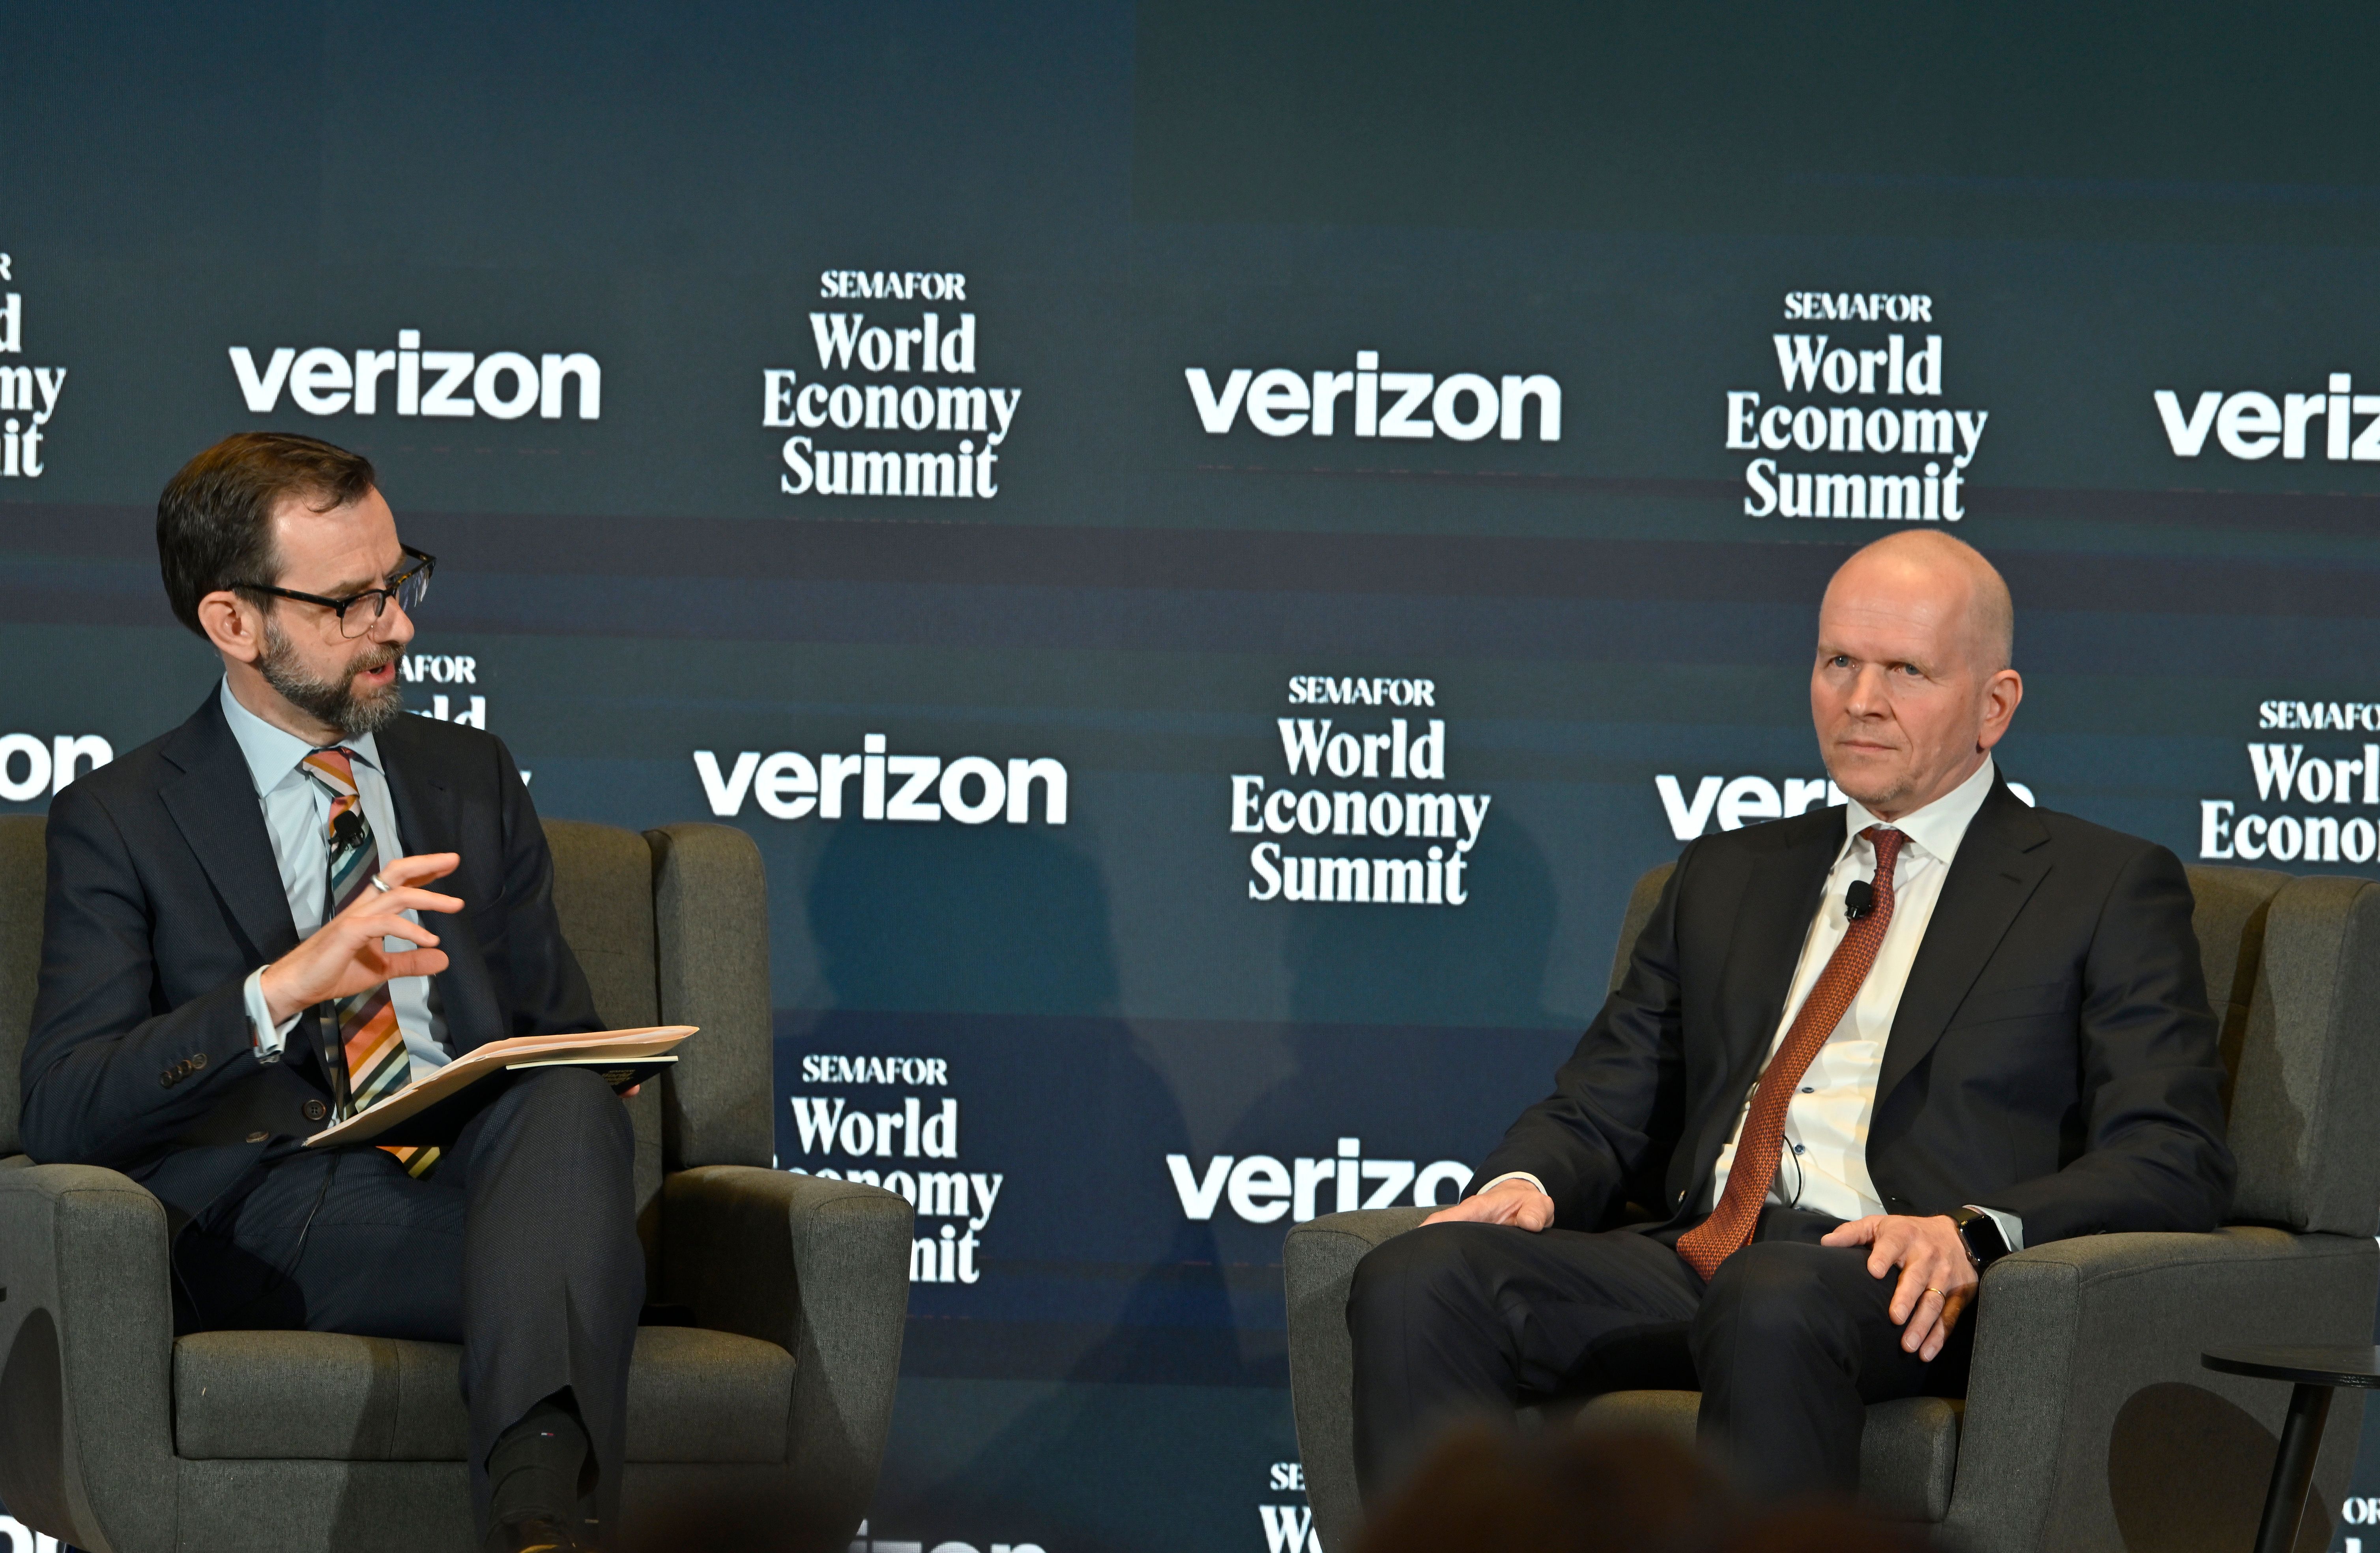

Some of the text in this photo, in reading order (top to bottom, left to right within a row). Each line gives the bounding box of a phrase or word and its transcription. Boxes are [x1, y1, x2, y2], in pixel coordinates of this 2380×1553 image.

[821, 270, 966, 301] SEMAFOR
[1785, 292, 1932, 322] SEMAFOR
[809, 312, 976, 373] World
[1773, 334, 1942, 395] World
[228, 329, 601, 420] verizon
[1184, 350, 1561, 442] verizon
[763, 369, 1022, 445] Economy
[1726, 390, 1988, 468] Economy
[781, 436, 998, 498] Summit
[1744, 458, 1965, 521] Summit
[1288, 676, 1435, 707] SEMAFOR
[693, 733, 1067, 825] verizon
[1277, 718, 1445, 779] World
[1230, 774, 1491, 852] Economy
[2199, 799, 2380, 863] Econo
[1249, 842, 1468, 905] Summit
[802, 1055, 947, 1085] SEMAFOR
[791, 1097, 957, 1158] World
